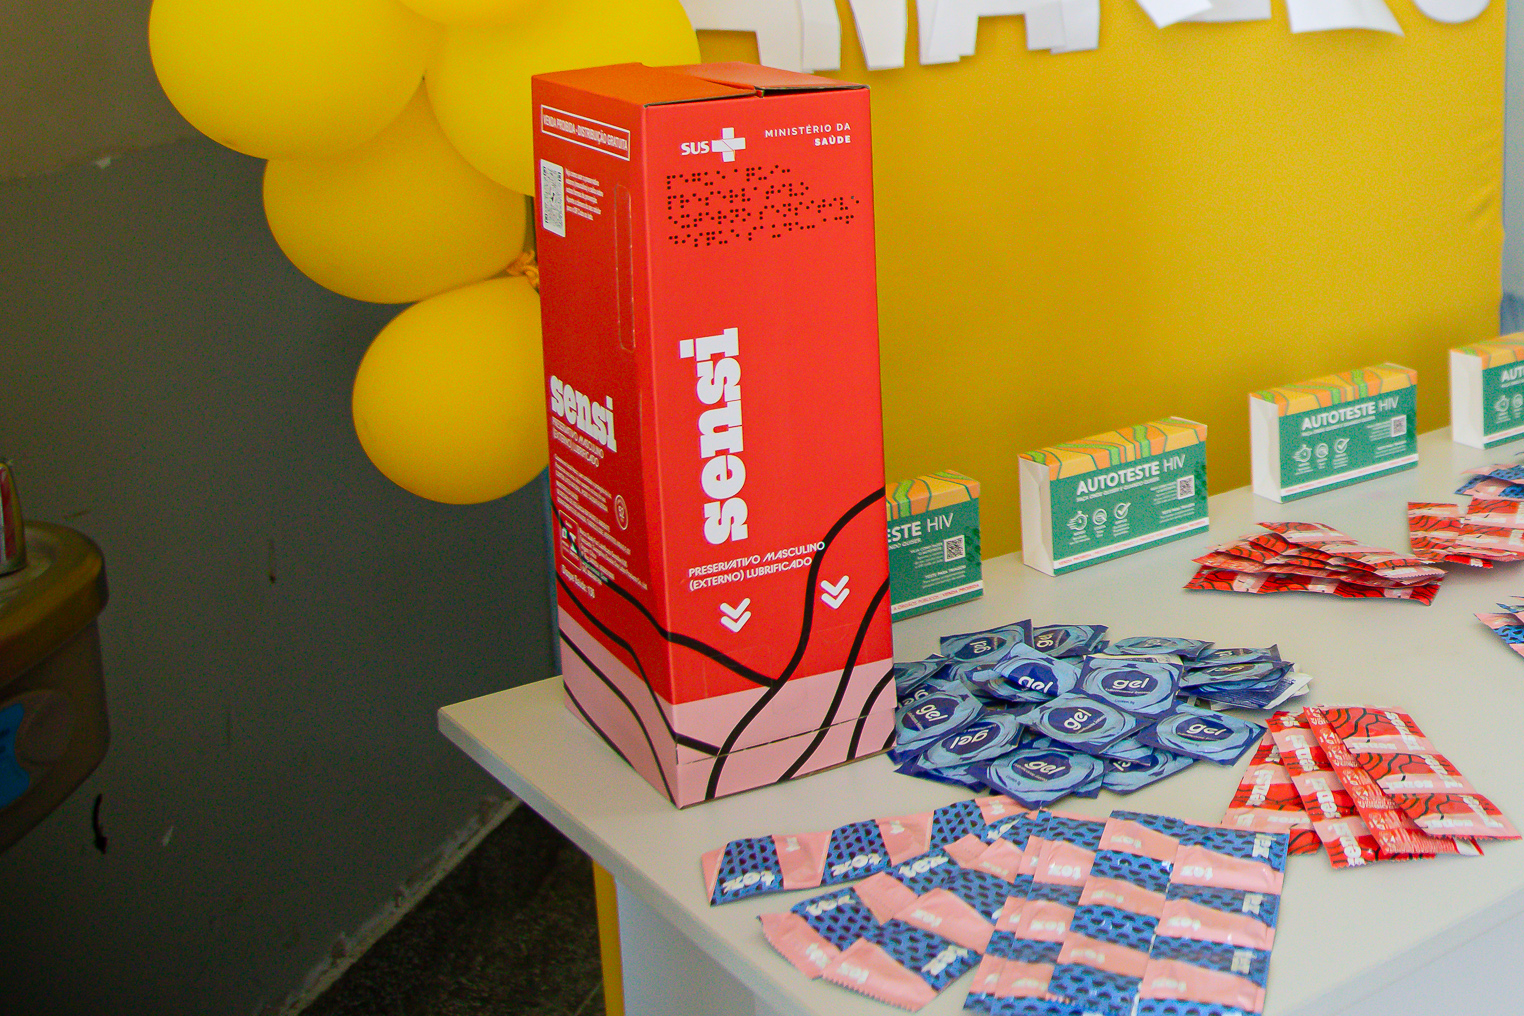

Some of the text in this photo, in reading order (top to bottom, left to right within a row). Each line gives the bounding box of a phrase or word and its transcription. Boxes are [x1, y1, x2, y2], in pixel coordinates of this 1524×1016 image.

[543, 114, 557, 129] VENDA
[607, 133, 628, 151] GRATUITA
[764, 122, 851, 138] MINISTÉRIO DA
[814, 134, 851, 147] SAÚDE
[680, 140, 710, 156] SUS
[550, 375, 618, 453] sensi
[1301, 397, 1399, 431] AUTOTESTE HIV
[679, 327, 748, 545] sensi
[1076, 461, 1160, 496] AUTOTESTE
[1163, 454, 1186, 472] HIV
[887, 513, 953, 543] ESTE HIV
[688, 541, 825, 578] PRESERVATIVO MASCULINO
[689, 557, 813, 591] (EXTERNO) LUBRIFICADO
[1113, 677, 1150, 690] gel
[916, 703, 949, 722] gel
[1064, 708, 1092, 730] gel
[949, 729, 990, 749] gel
[1185, 722, 1227, 736] gel
[1024, 760, 1066, 775] gel
[1246, 770, 1275, 806] sensi
[1305, 777, 1341, 818] sensi
